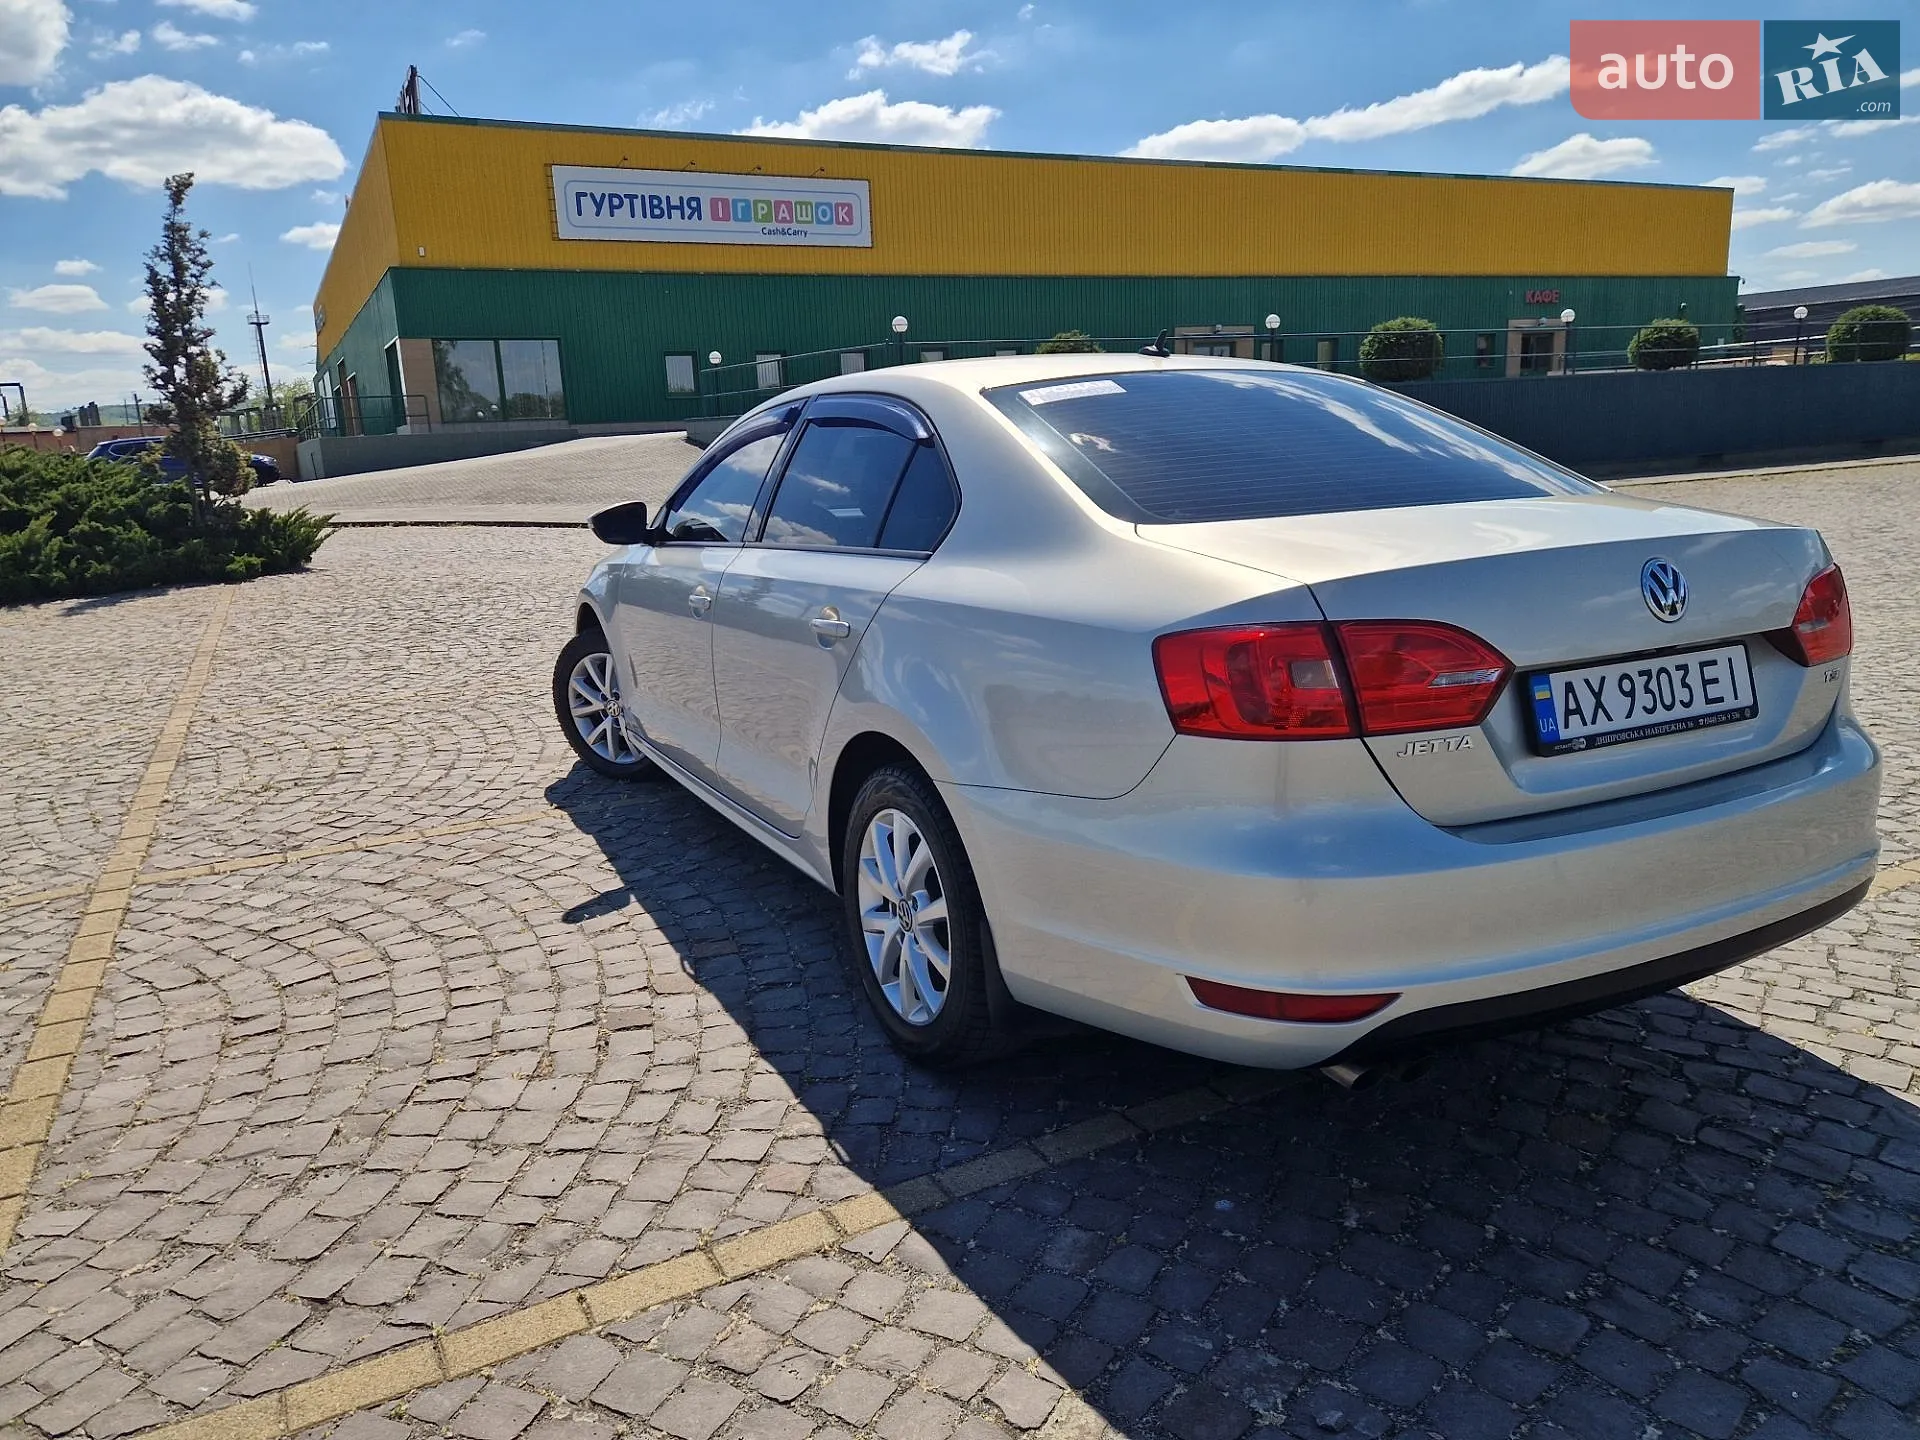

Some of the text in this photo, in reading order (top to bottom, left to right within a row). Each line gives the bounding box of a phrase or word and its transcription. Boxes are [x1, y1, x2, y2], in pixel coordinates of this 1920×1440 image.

[574, 191, 852, 225] ГУРТІВНЯ ІГРАШОК
[761, 227, 808, 238] Cash&Carry
[1525, 290, 1560, 304] КАФЕ
[1563, 657, 1739, 730] AX 9303 EI
[1539, 718, 1556, 733] UA
[1396, 735, 1474, 758] JETTA
